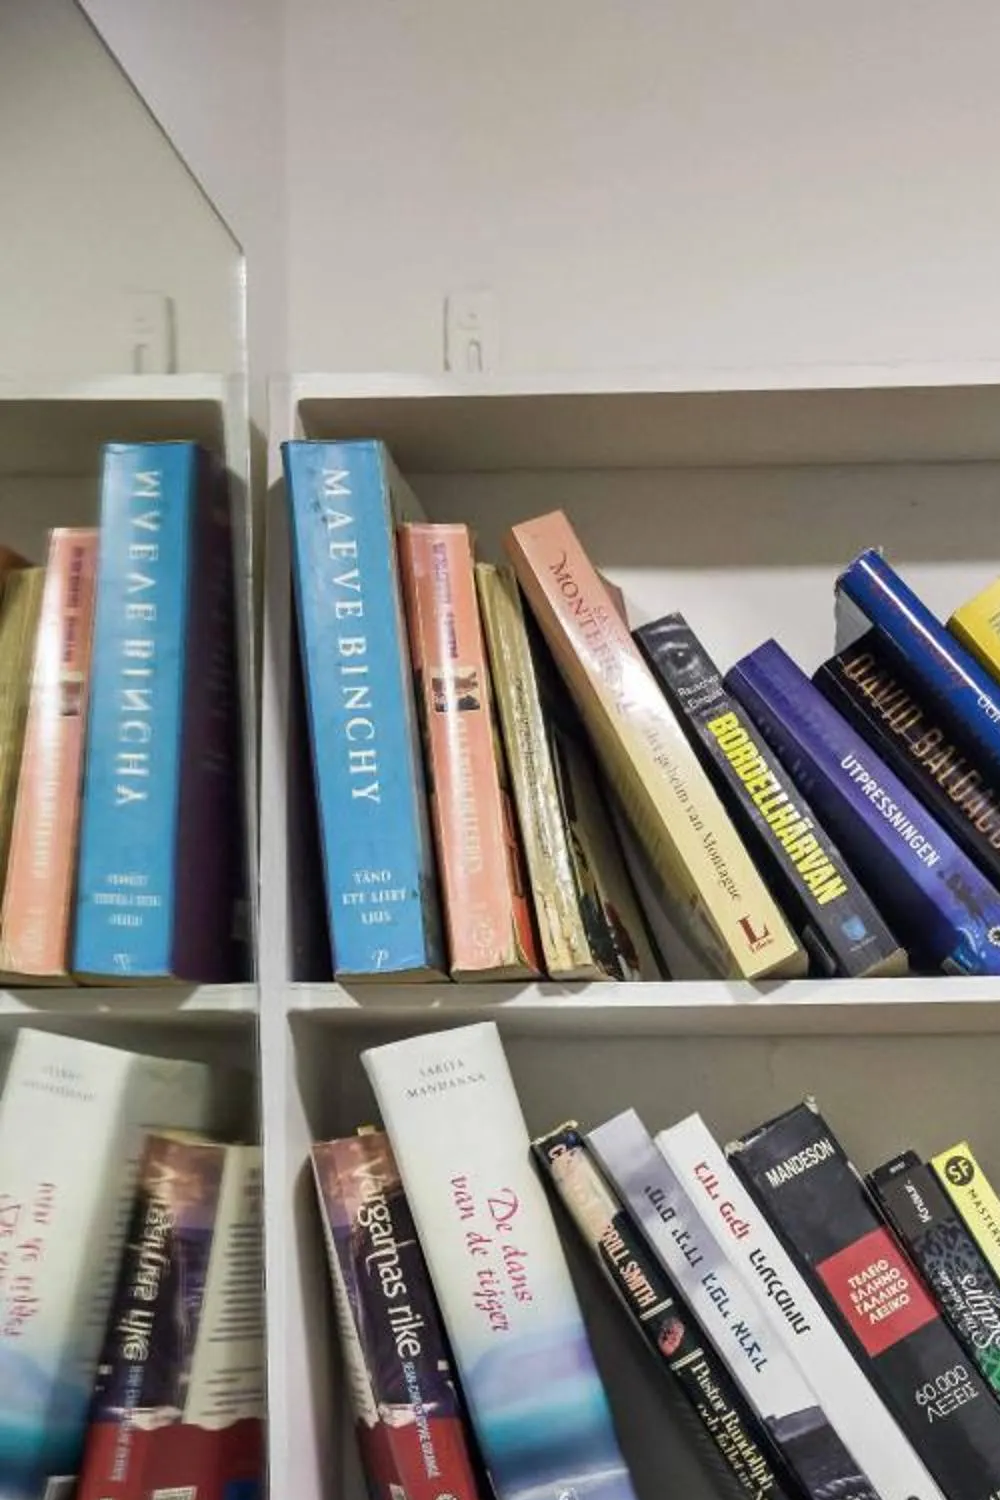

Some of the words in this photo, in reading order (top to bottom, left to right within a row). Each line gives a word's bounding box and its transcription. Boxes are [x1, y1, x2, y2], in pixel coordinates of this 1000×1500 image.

[319, 464, 362, 620] MAEVE
[336, 632, 380, 807] BINCHY
[837, 647, 926, 739] DAVID
[704, 707, 854, 908] BORDELLHÄRVAN
[836, 752, 942, 869] UTPRESSNINGEN
[681, 801, 704, 832] van
[694, 829, 746, 904] Montague
[405, 1072, 487, 1099] MANDANNA
[762, 1135, 836, 1190] MANDESON
[947, 1159, 970, 1183] SF
[448, 1172, 481, 1222] van
[484, 1184, 526, 1235] De
[463, 1225, 496, 1260] de
[465, 1264, 513, 1336] tijger
[498, 1239, 539, 1306] dans
[616, 1257, 659, 1309] SMITH
[387, 1301, 429, 1360] rike
[910, 1362, 971, 1408] 60.000
[920, 1379, 980, 1425] ΛΕΞΕΙΣ
